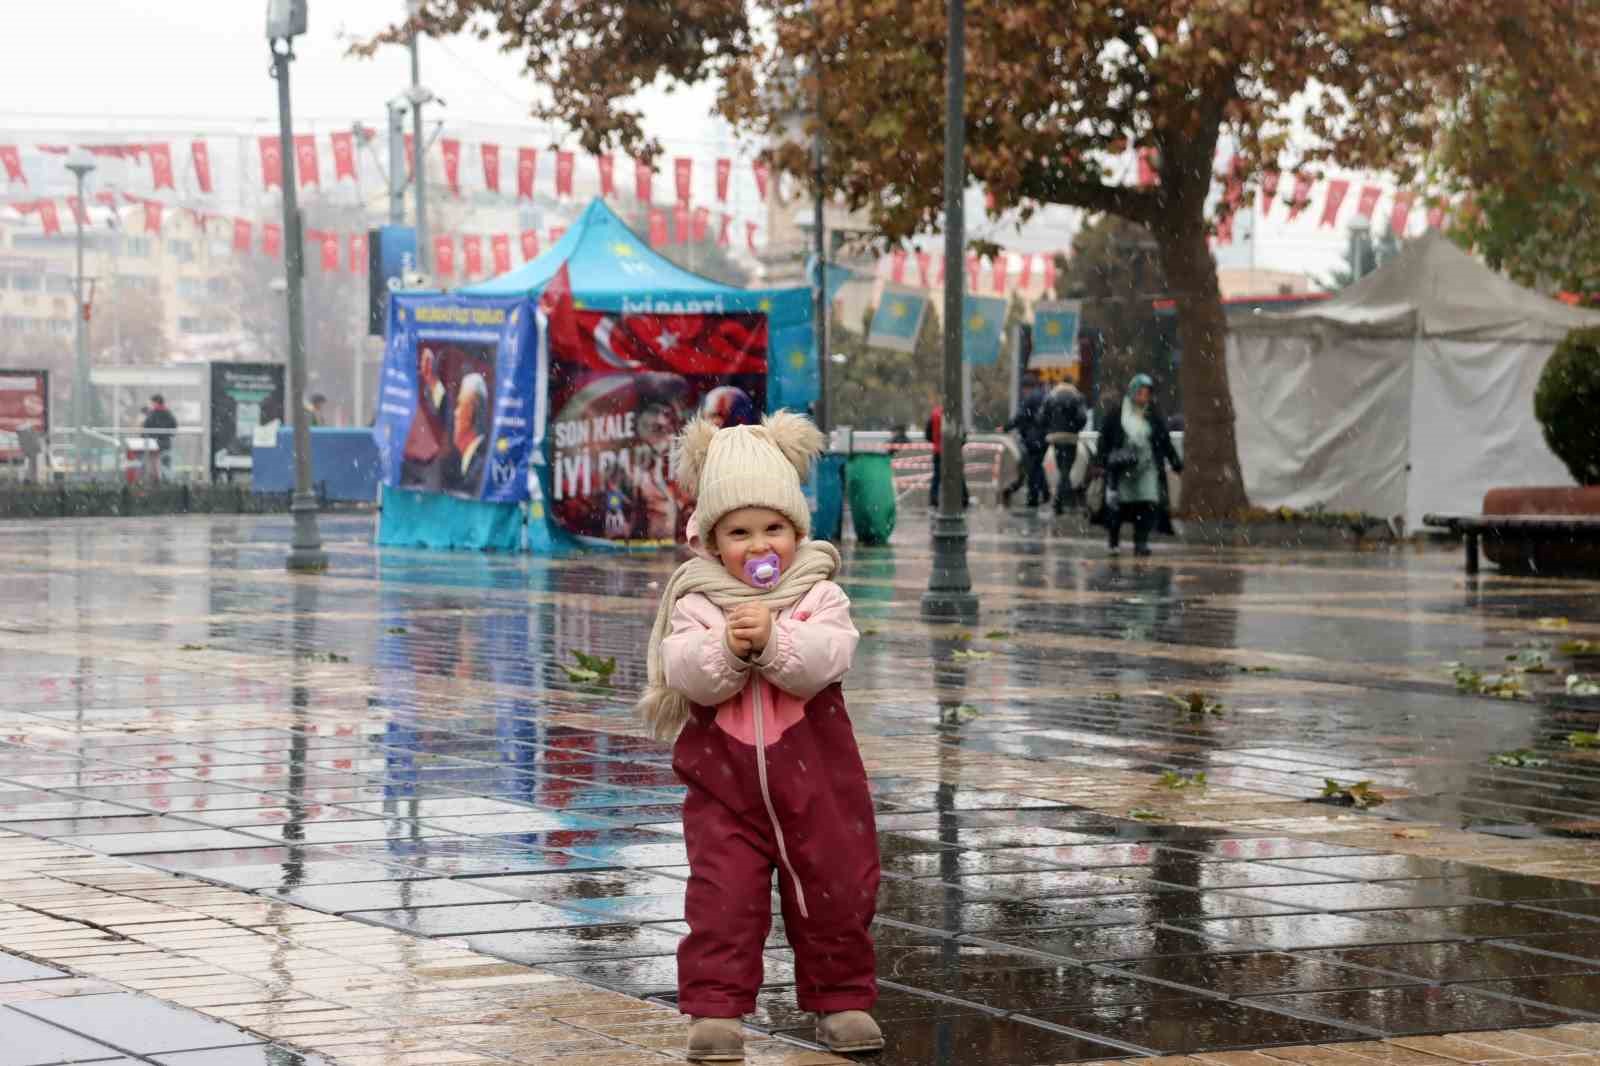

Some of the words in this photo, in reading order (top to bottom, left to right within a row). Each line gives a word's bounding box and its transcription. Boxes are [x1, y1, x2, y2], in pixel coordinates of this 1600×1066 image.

[554, 420, 591, 448] SON
[594, 411, 635, 443] KALE
[554, 448, 592, 500] İYİ
